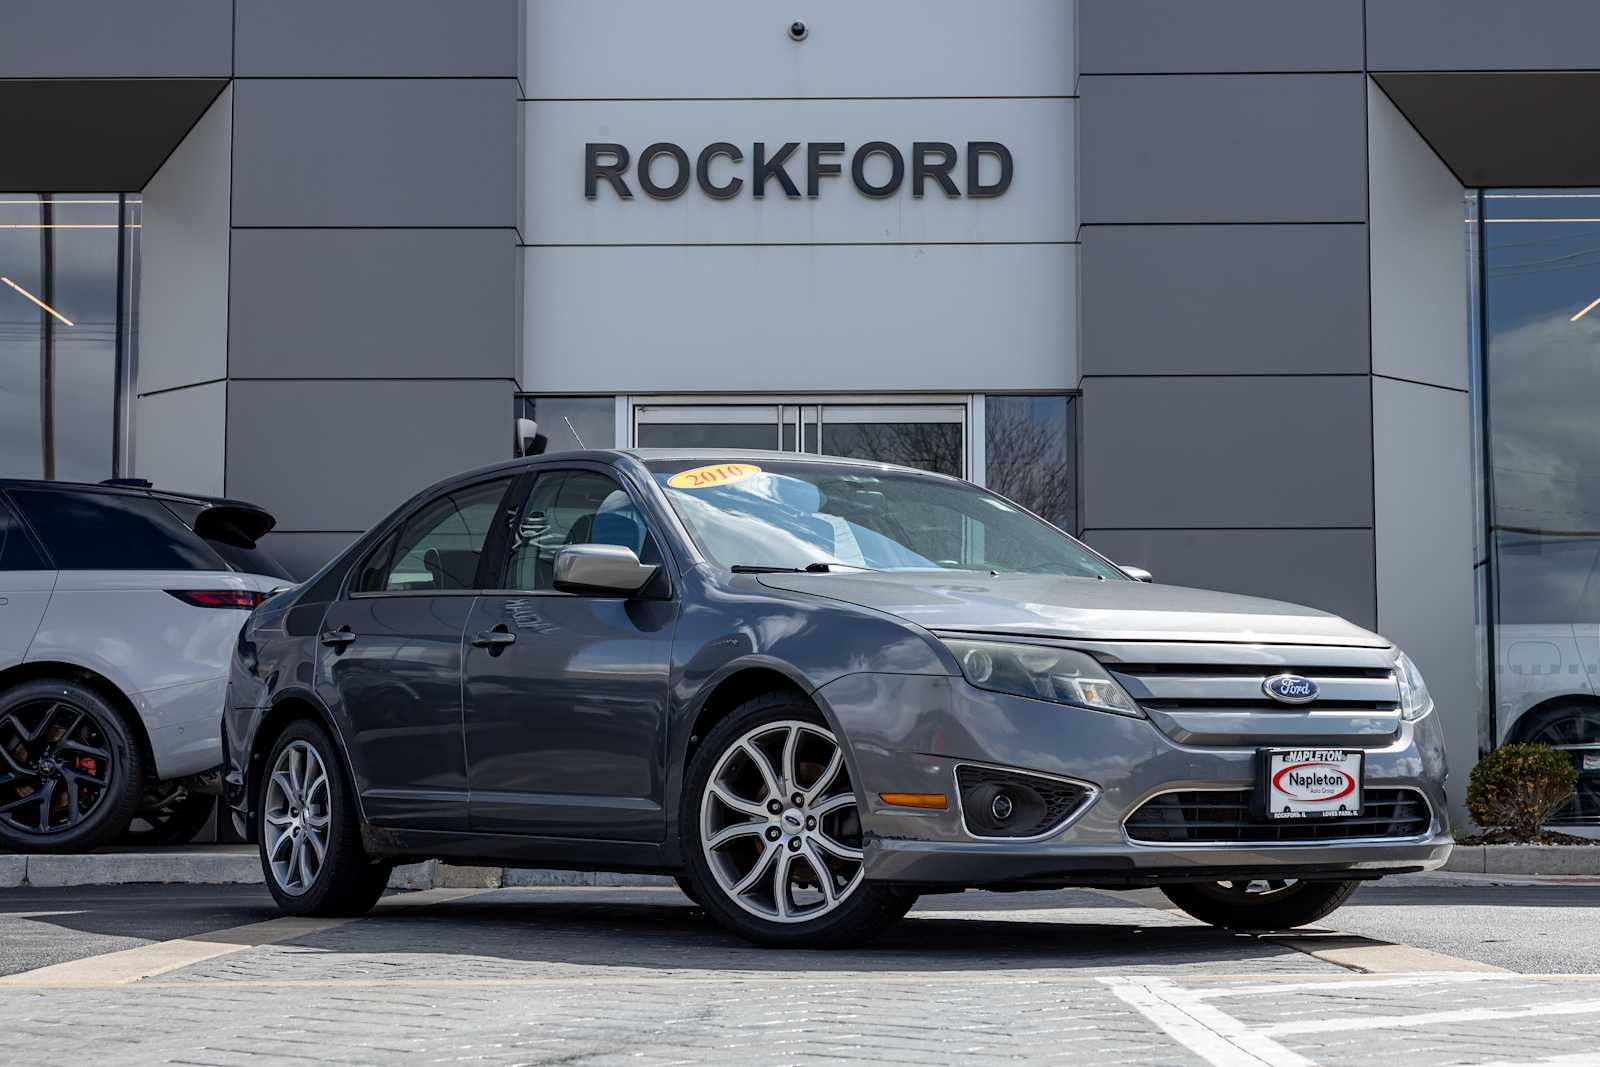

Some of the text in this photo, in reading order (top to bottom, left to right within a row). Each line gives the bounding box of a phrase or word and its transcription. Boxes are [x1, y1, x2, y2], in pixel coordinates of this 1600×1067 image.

[584, 141, 1014, 199] ROCKFORD
[686, 465, 743, 486] 2010
[1280, 678, 1311, 695] Ford
[1289, 750, 1343, 762] NAPLETON
[1289, 772, 1343, 789] Napleton
